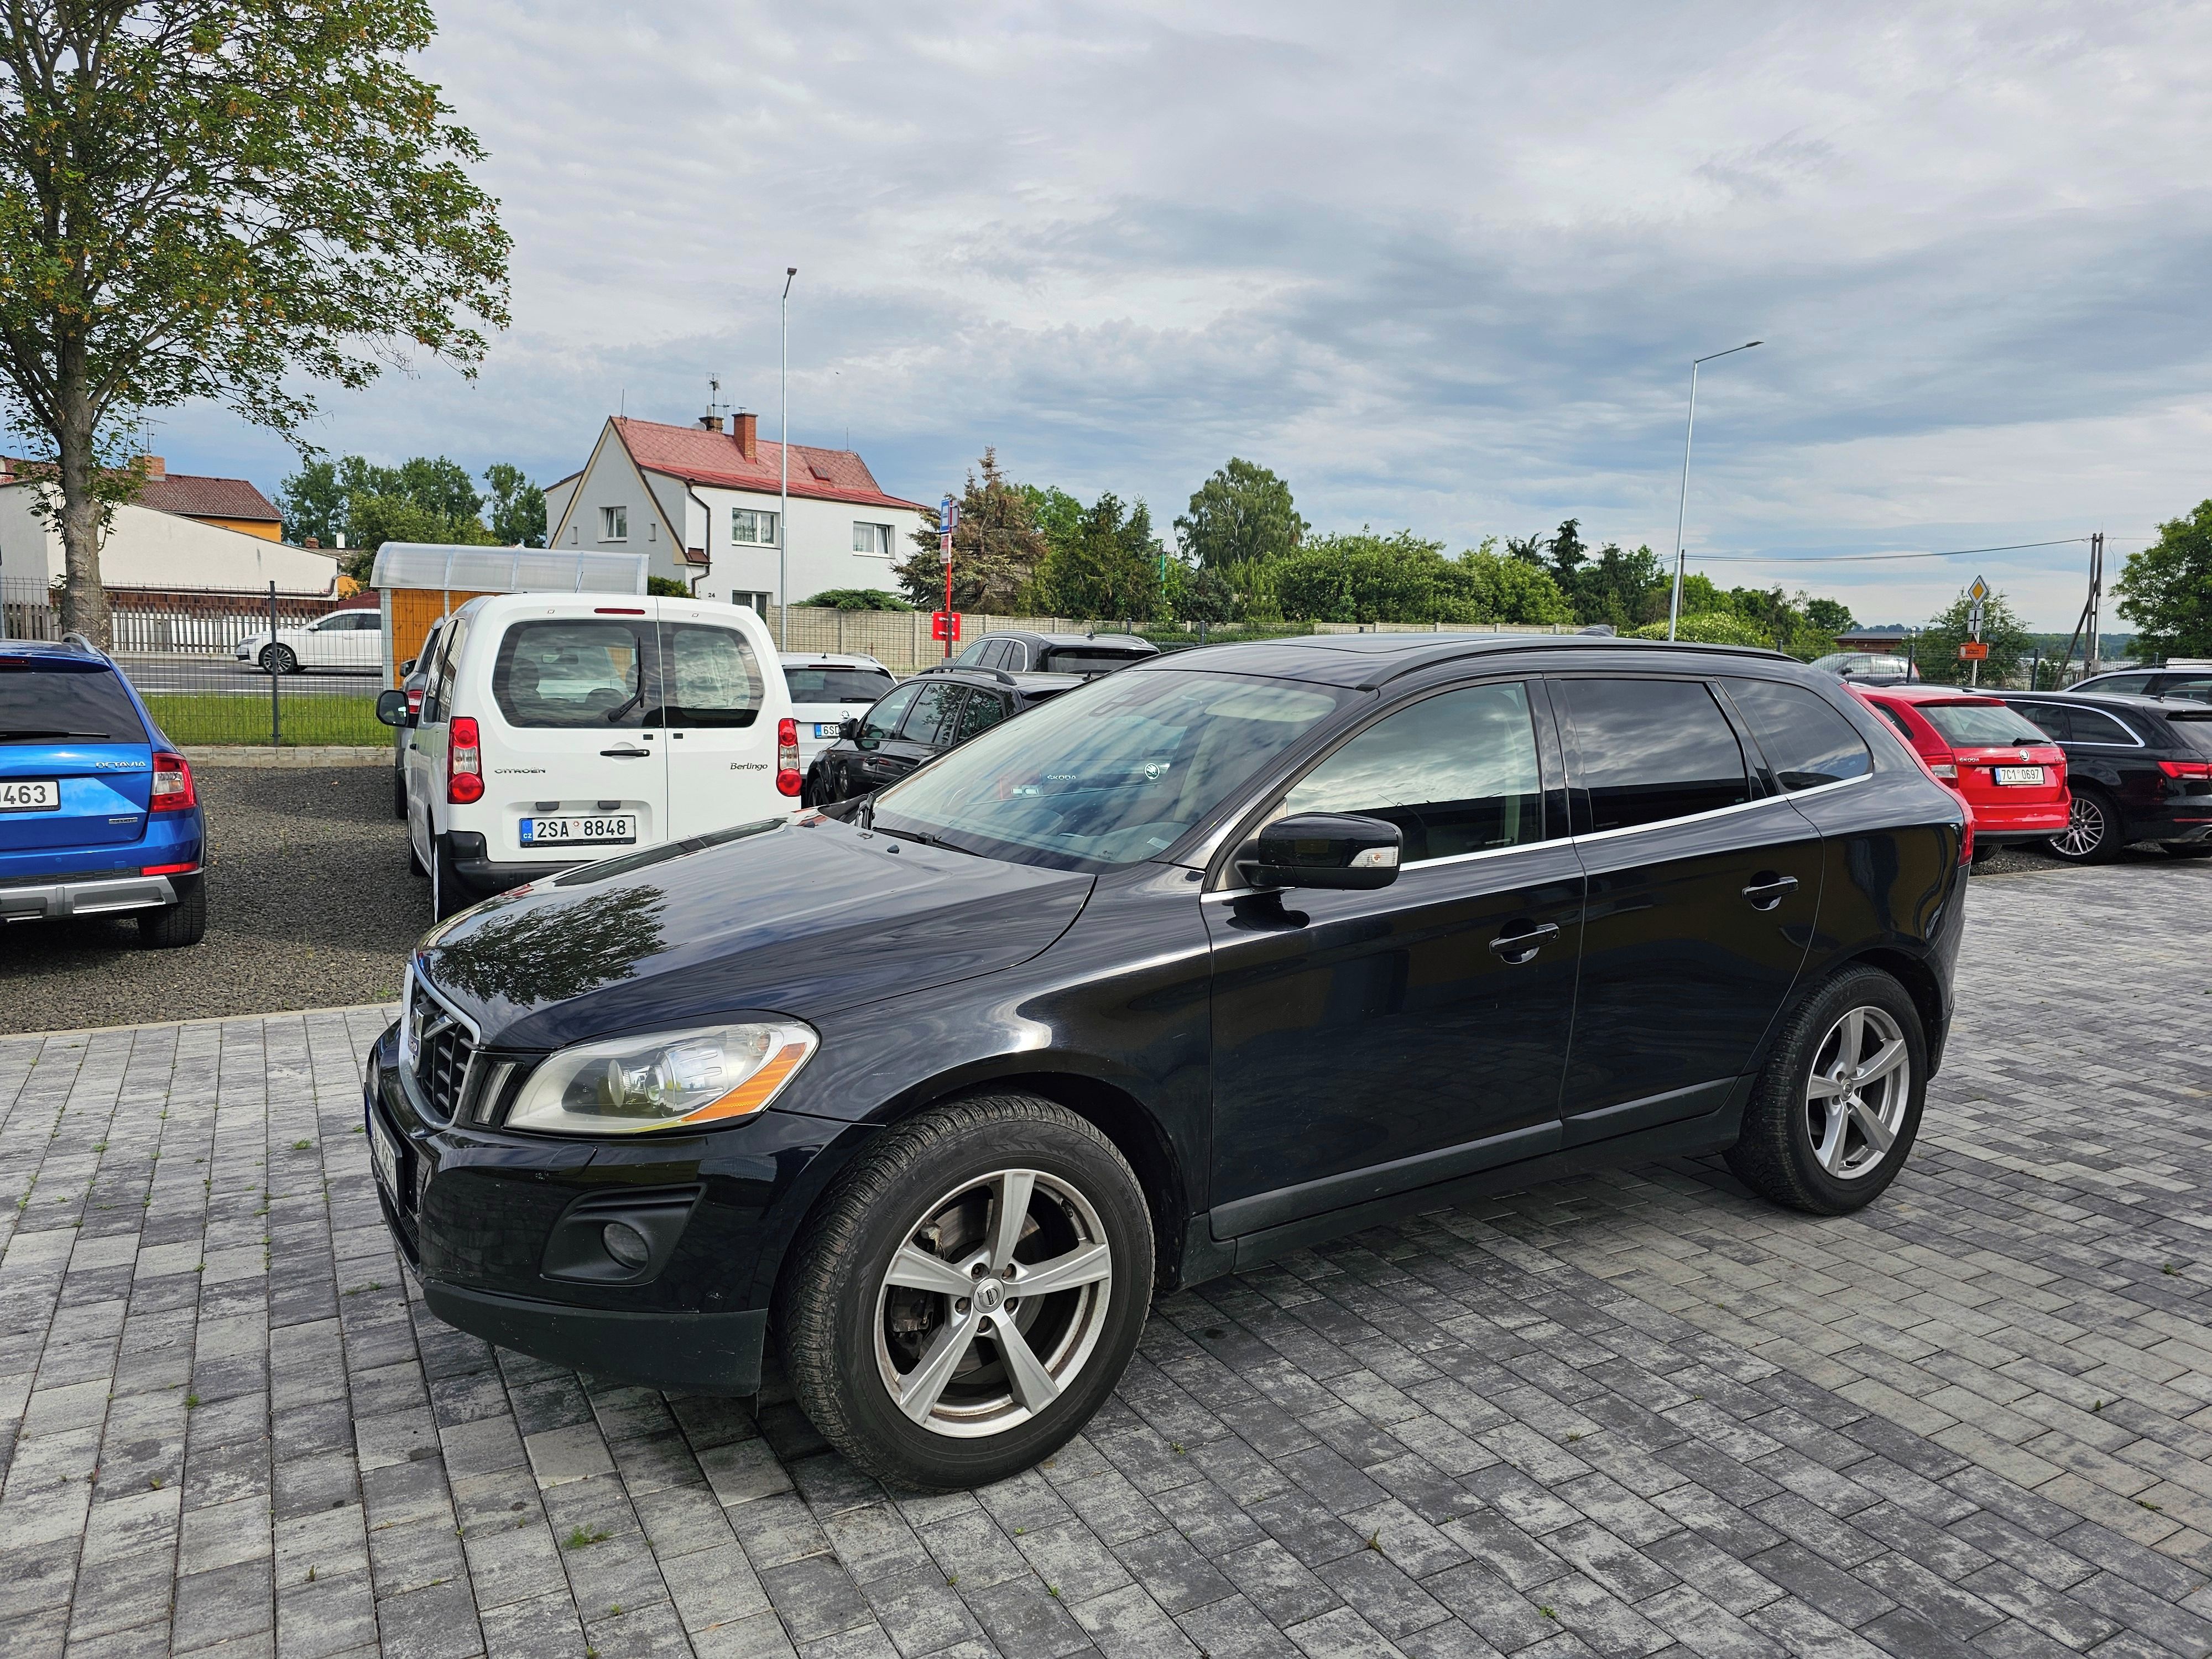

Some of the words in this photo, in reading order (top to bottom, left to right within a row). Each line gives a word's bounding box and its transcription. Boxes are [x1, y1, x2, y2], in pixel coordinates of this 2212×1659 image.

[730, 762, 768, 771] Berlingo
[2001, 770, 2016, 780] 7C1
[2021, 769, 2039, 779] 0697
[0, 785, 46, 805] 463
[537, 821, 569, 838] 2SA
[584, 820, 625, 836] 8848
